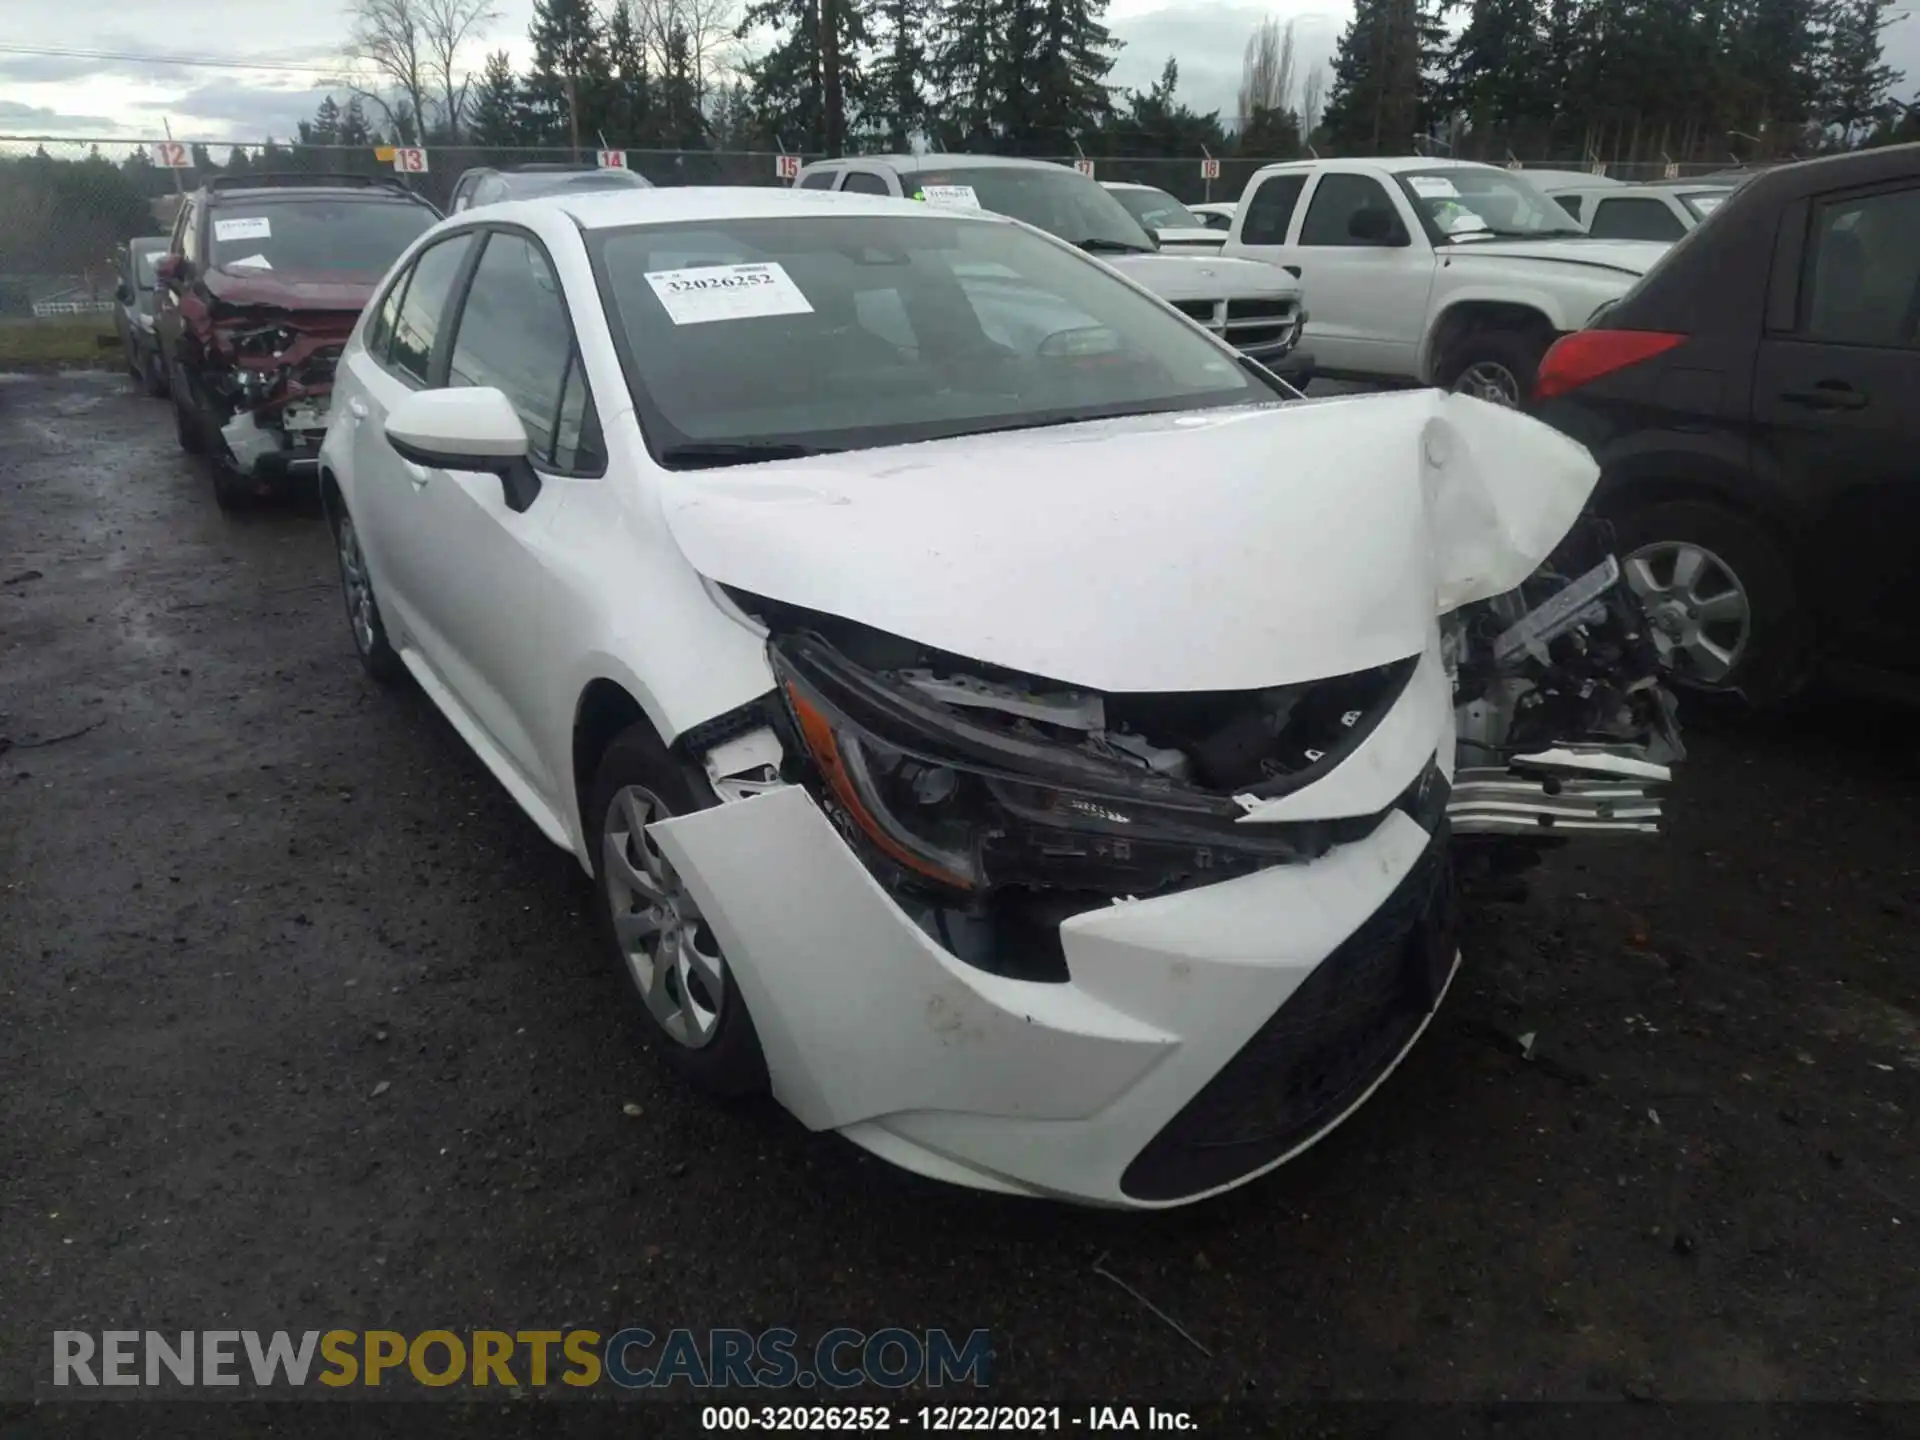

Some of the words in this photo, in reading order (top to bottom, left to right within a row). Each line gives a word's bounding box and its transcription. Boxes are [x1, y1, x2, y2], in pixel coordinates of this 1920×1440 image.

[159, 144, 188, 165] 12
[399, 149, 422, 171] 13
[602, 151, 622, 168] 14
[780, 156, 798, 177] 15
[667, 274, 775, 294] 32026252
